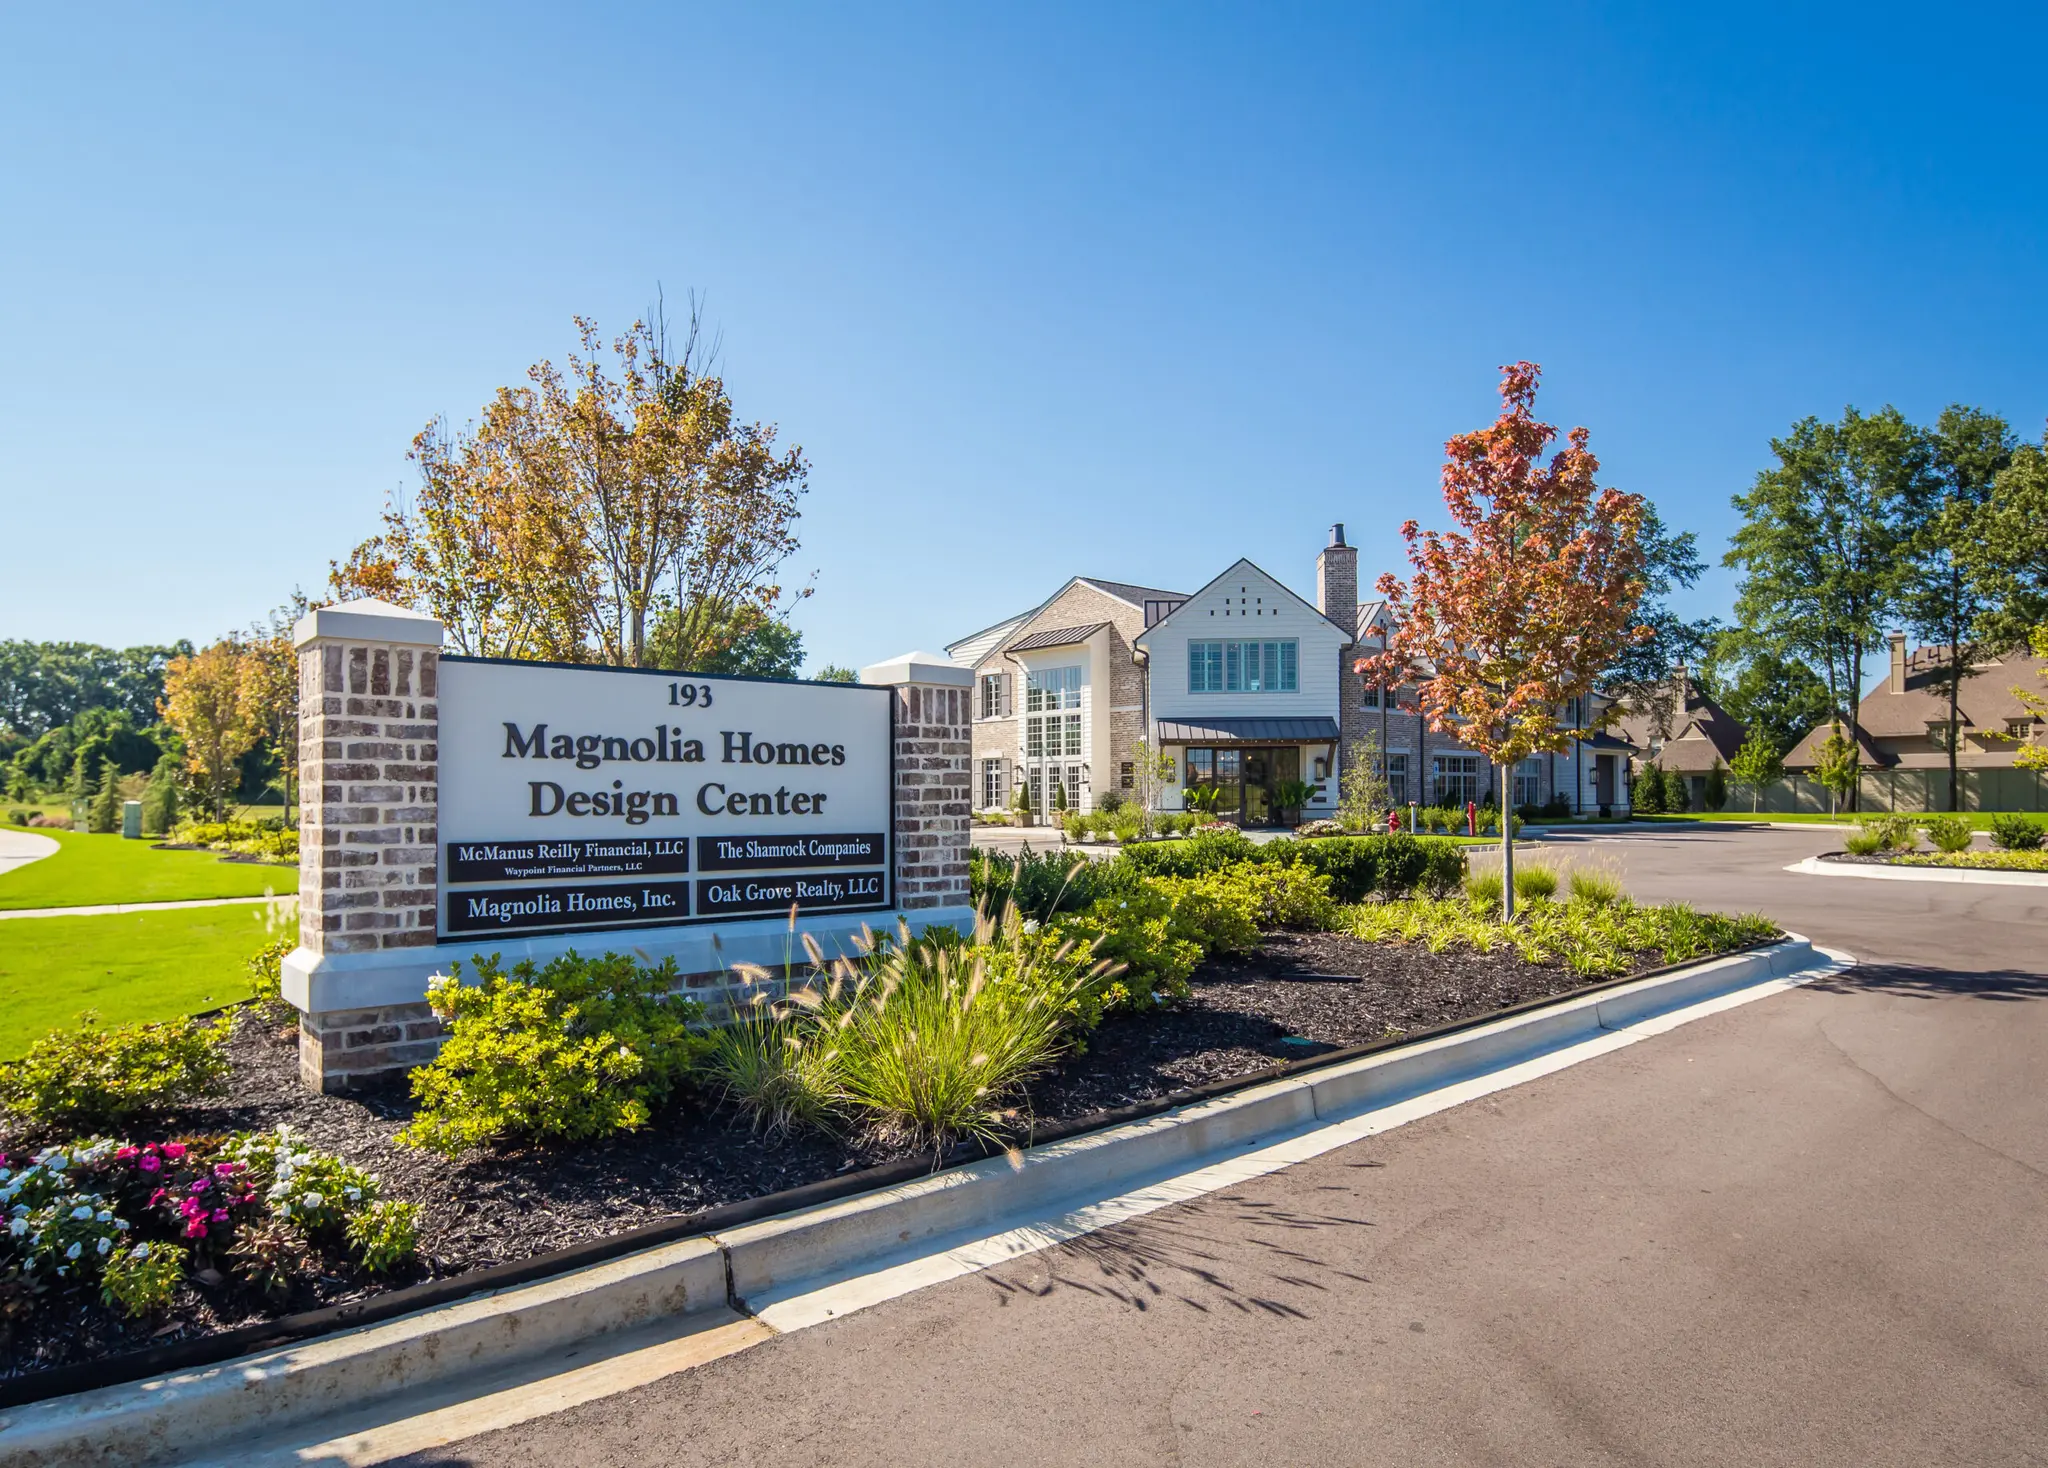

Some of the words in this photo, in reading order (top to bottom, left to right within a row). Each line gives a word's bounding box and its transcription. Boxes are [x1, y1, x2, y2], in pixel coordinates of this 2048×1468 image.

[668, 683, 713, 707] 193
[502, 722, 705, 769] Magnolia
[720, 731, 846, 766] Homes
[528, 780, 680, 825] Design
[697, 783, 827, 815] Center
[459, 845, 534, 861] McManus
[538, 843, 581, 862] Reilly
[585, 842, 652, 858] Financial,
[655, 841, 684, 855] LLC
[717, 841, 743, 859] The
[746, 840, 806, 858] Shamrock
[809, 838, 871, 861] Companies
[504, 866, 546, 877] Waypoint
[547, 864, 586, 874] Financial
[588, 863, 624, 872] Partners,
[625, 862, 643, 871] LLC
[708, 884, 741, 903] Oak
[745, 883, 792, 901] Grove
[796, 880, 844, 901] Realty,
[848, 877, 878, 895] LLC
[468, 894, 561, 923] Magnolia
[567, 893, 637, 912] Homes,
[642, 889, 676, 908] Inc.
